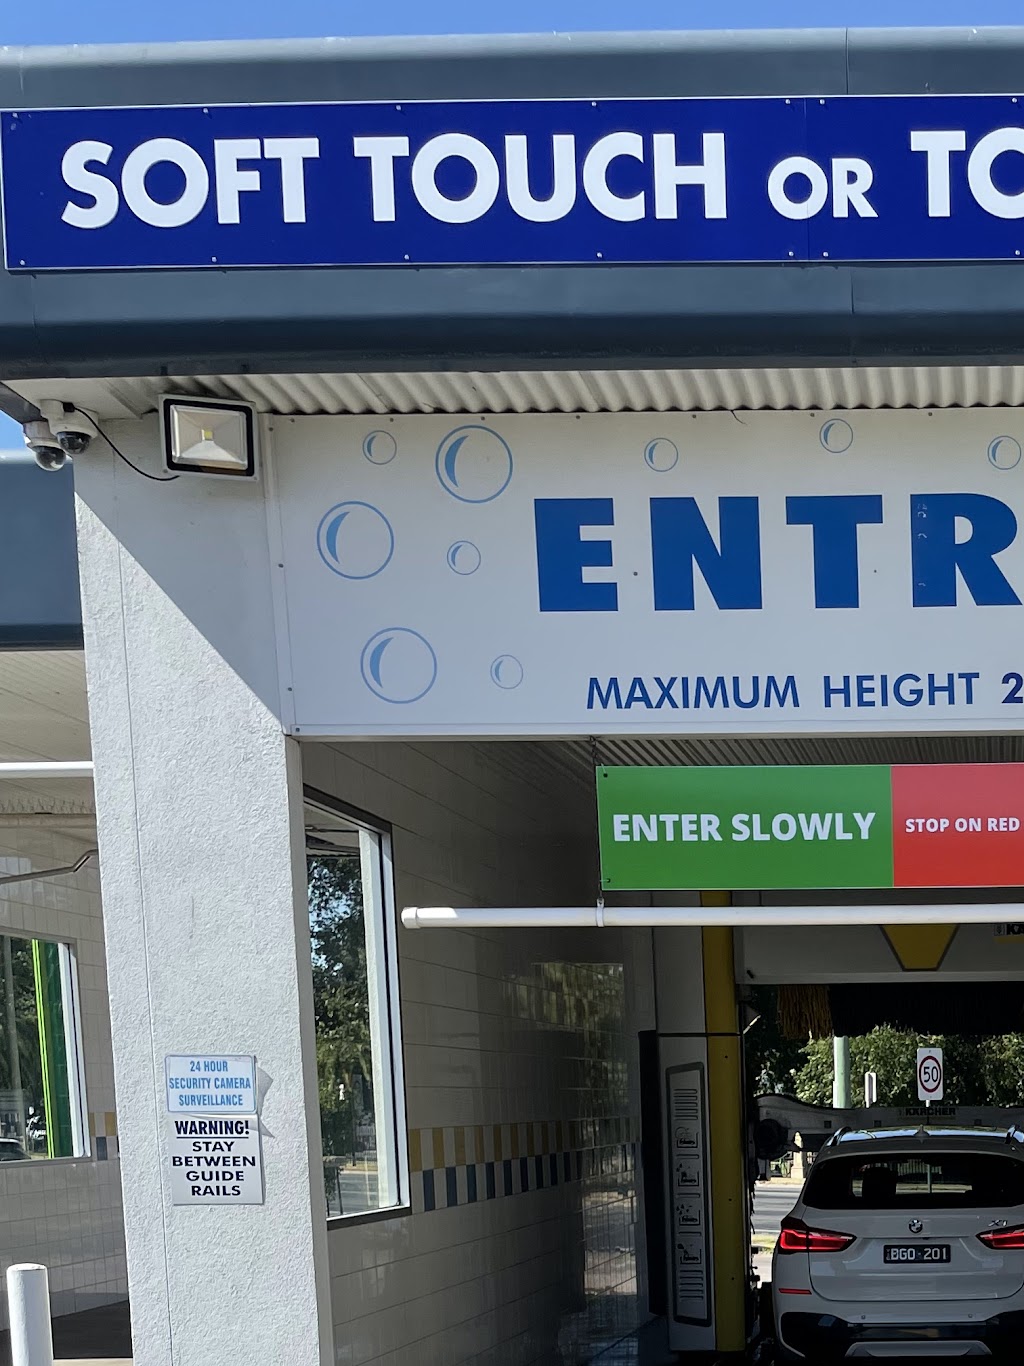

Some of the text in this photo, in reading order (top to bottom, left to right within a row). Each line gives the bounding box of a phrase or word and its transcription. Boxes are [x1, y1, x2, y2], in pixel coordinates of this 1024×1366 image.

[61, 137, 320, 229] SOFT
[353, 132, 728, 223] TOUCH
[767, 156, 878, 219] OR
[586, 675, 800, 710] MAXIMUM
[823, 672, 980, 708] HEIGHT
[613, 811, 876, 842] ENTER SLOWLY
[905, 817, 950, 833] STOP
[954, 817, 982, 833] ON
[986, 817, 1020, 833] RED
[190, 1060, 228, 1072] 24 HOUR
[923, 1066, 938, 1083] 50
[169, 1077, 251, 1090] SECURITY CAMERA
[178, 1094, 243, 1106] SURVEILLANCE
[175, 1120, 249, 1135] WARNING!
[192, 1141, 235, 1152] STAY
[172, 1156, 256, 1167] BETWEEN
[186, 1170, 245, 1181] GUIDE
[191, 1185, 241, 1196] RAILS
[923, 1247, 947, 1260] 201
